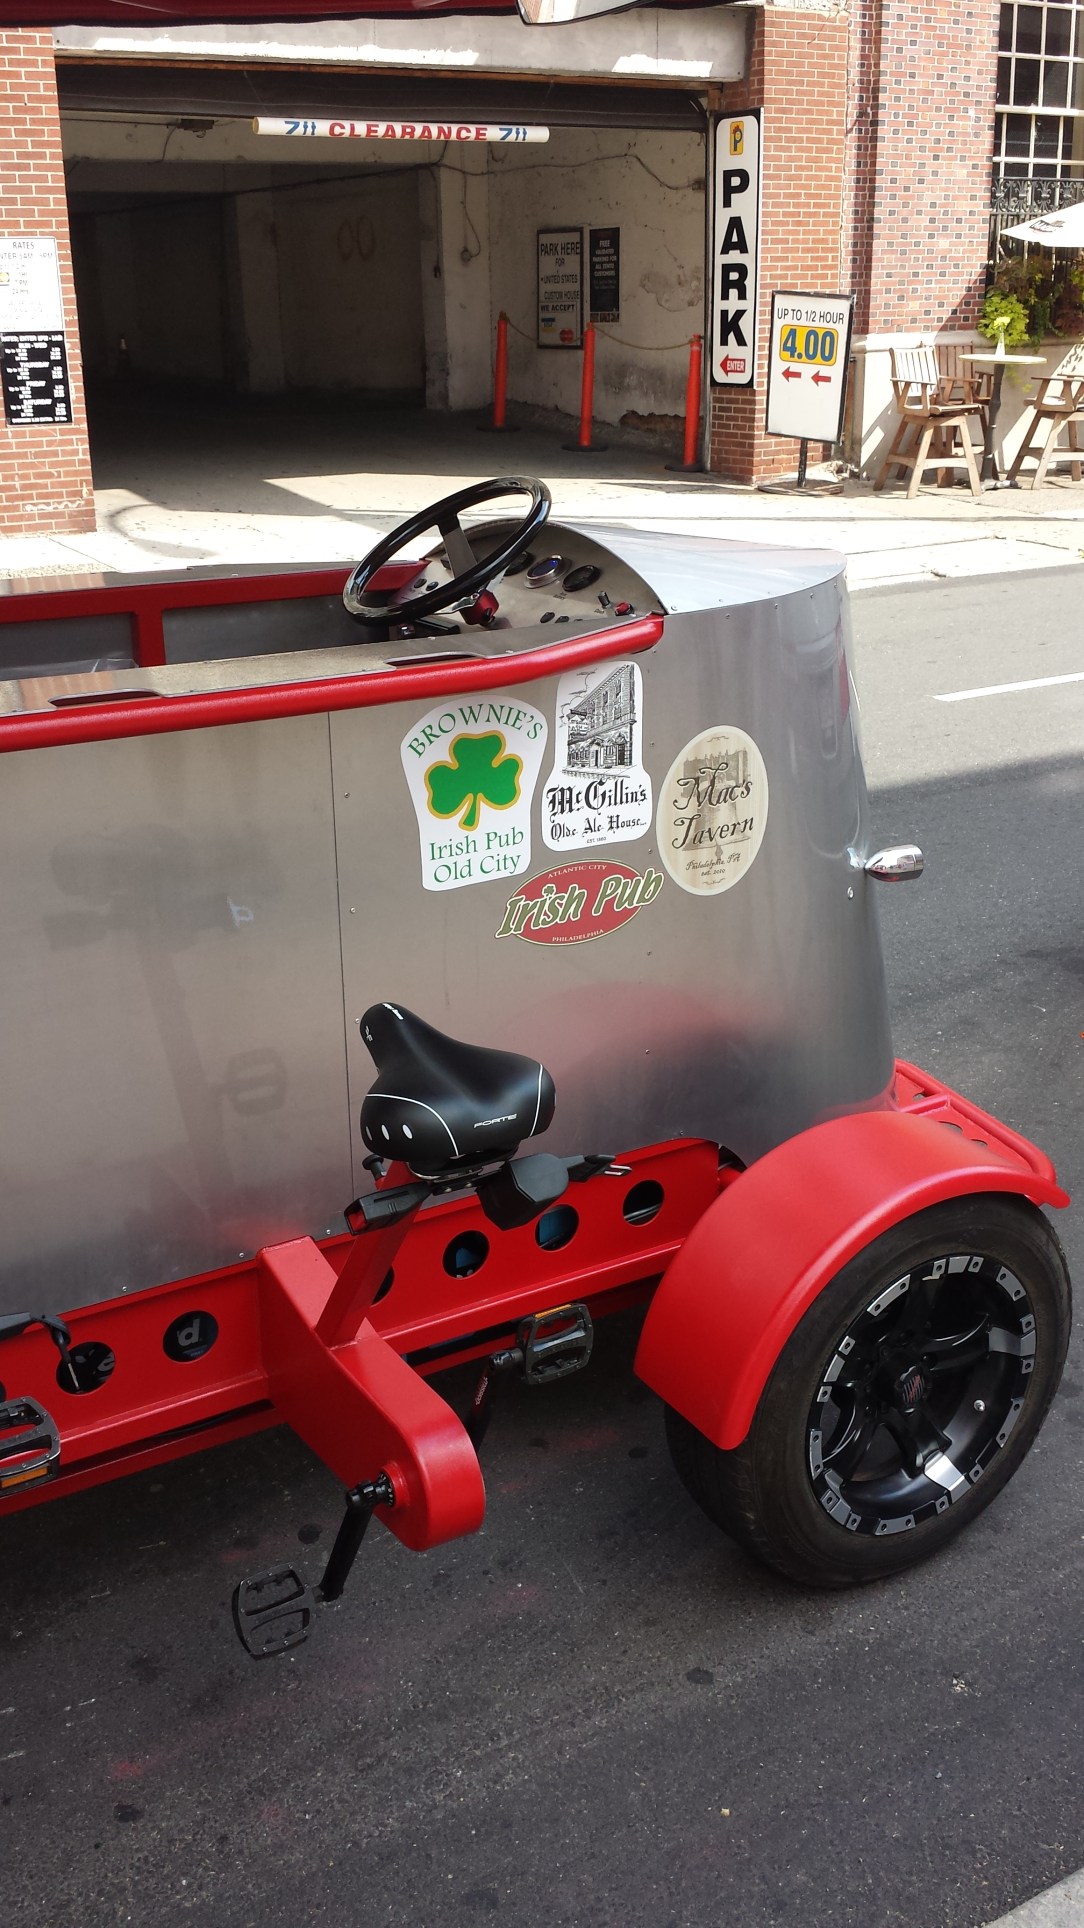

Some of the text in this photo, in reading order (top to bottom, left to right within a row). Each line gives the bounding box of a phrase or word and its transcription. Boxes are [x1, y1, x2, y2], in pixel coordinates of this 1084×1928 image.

[328, 122, 488, 141] CLEARANCE
[12, 241, 35, 249] RATES
[540, 242, 580, 256] PARK HERE
[555, 258, 565, 267] FOR
[719, 168, 750, 347] PARK
[561, 274, 578, 283] STATES
[564, 290, 580, 299] HOUSE
[777, 307, 845, 325] UP TO 1/2 HOUR
[782, 328, 835, 362] 4.00
[726, 359, 745, 371] ENTER
[407, 703, 543, 758] BROWNIE'S
[672, 762, 752, 810] Mac's
[671, 814, 754, 849] Tavern
[429, 826, 524, 860] Irish Pub
[434, 853, 521, 883] Old City
[547, 865, 587, 879] ATLANTIC
[495, 868, 664, 938] Irish Pub
[551, 929, 604, 942] PHILADELPHIA
